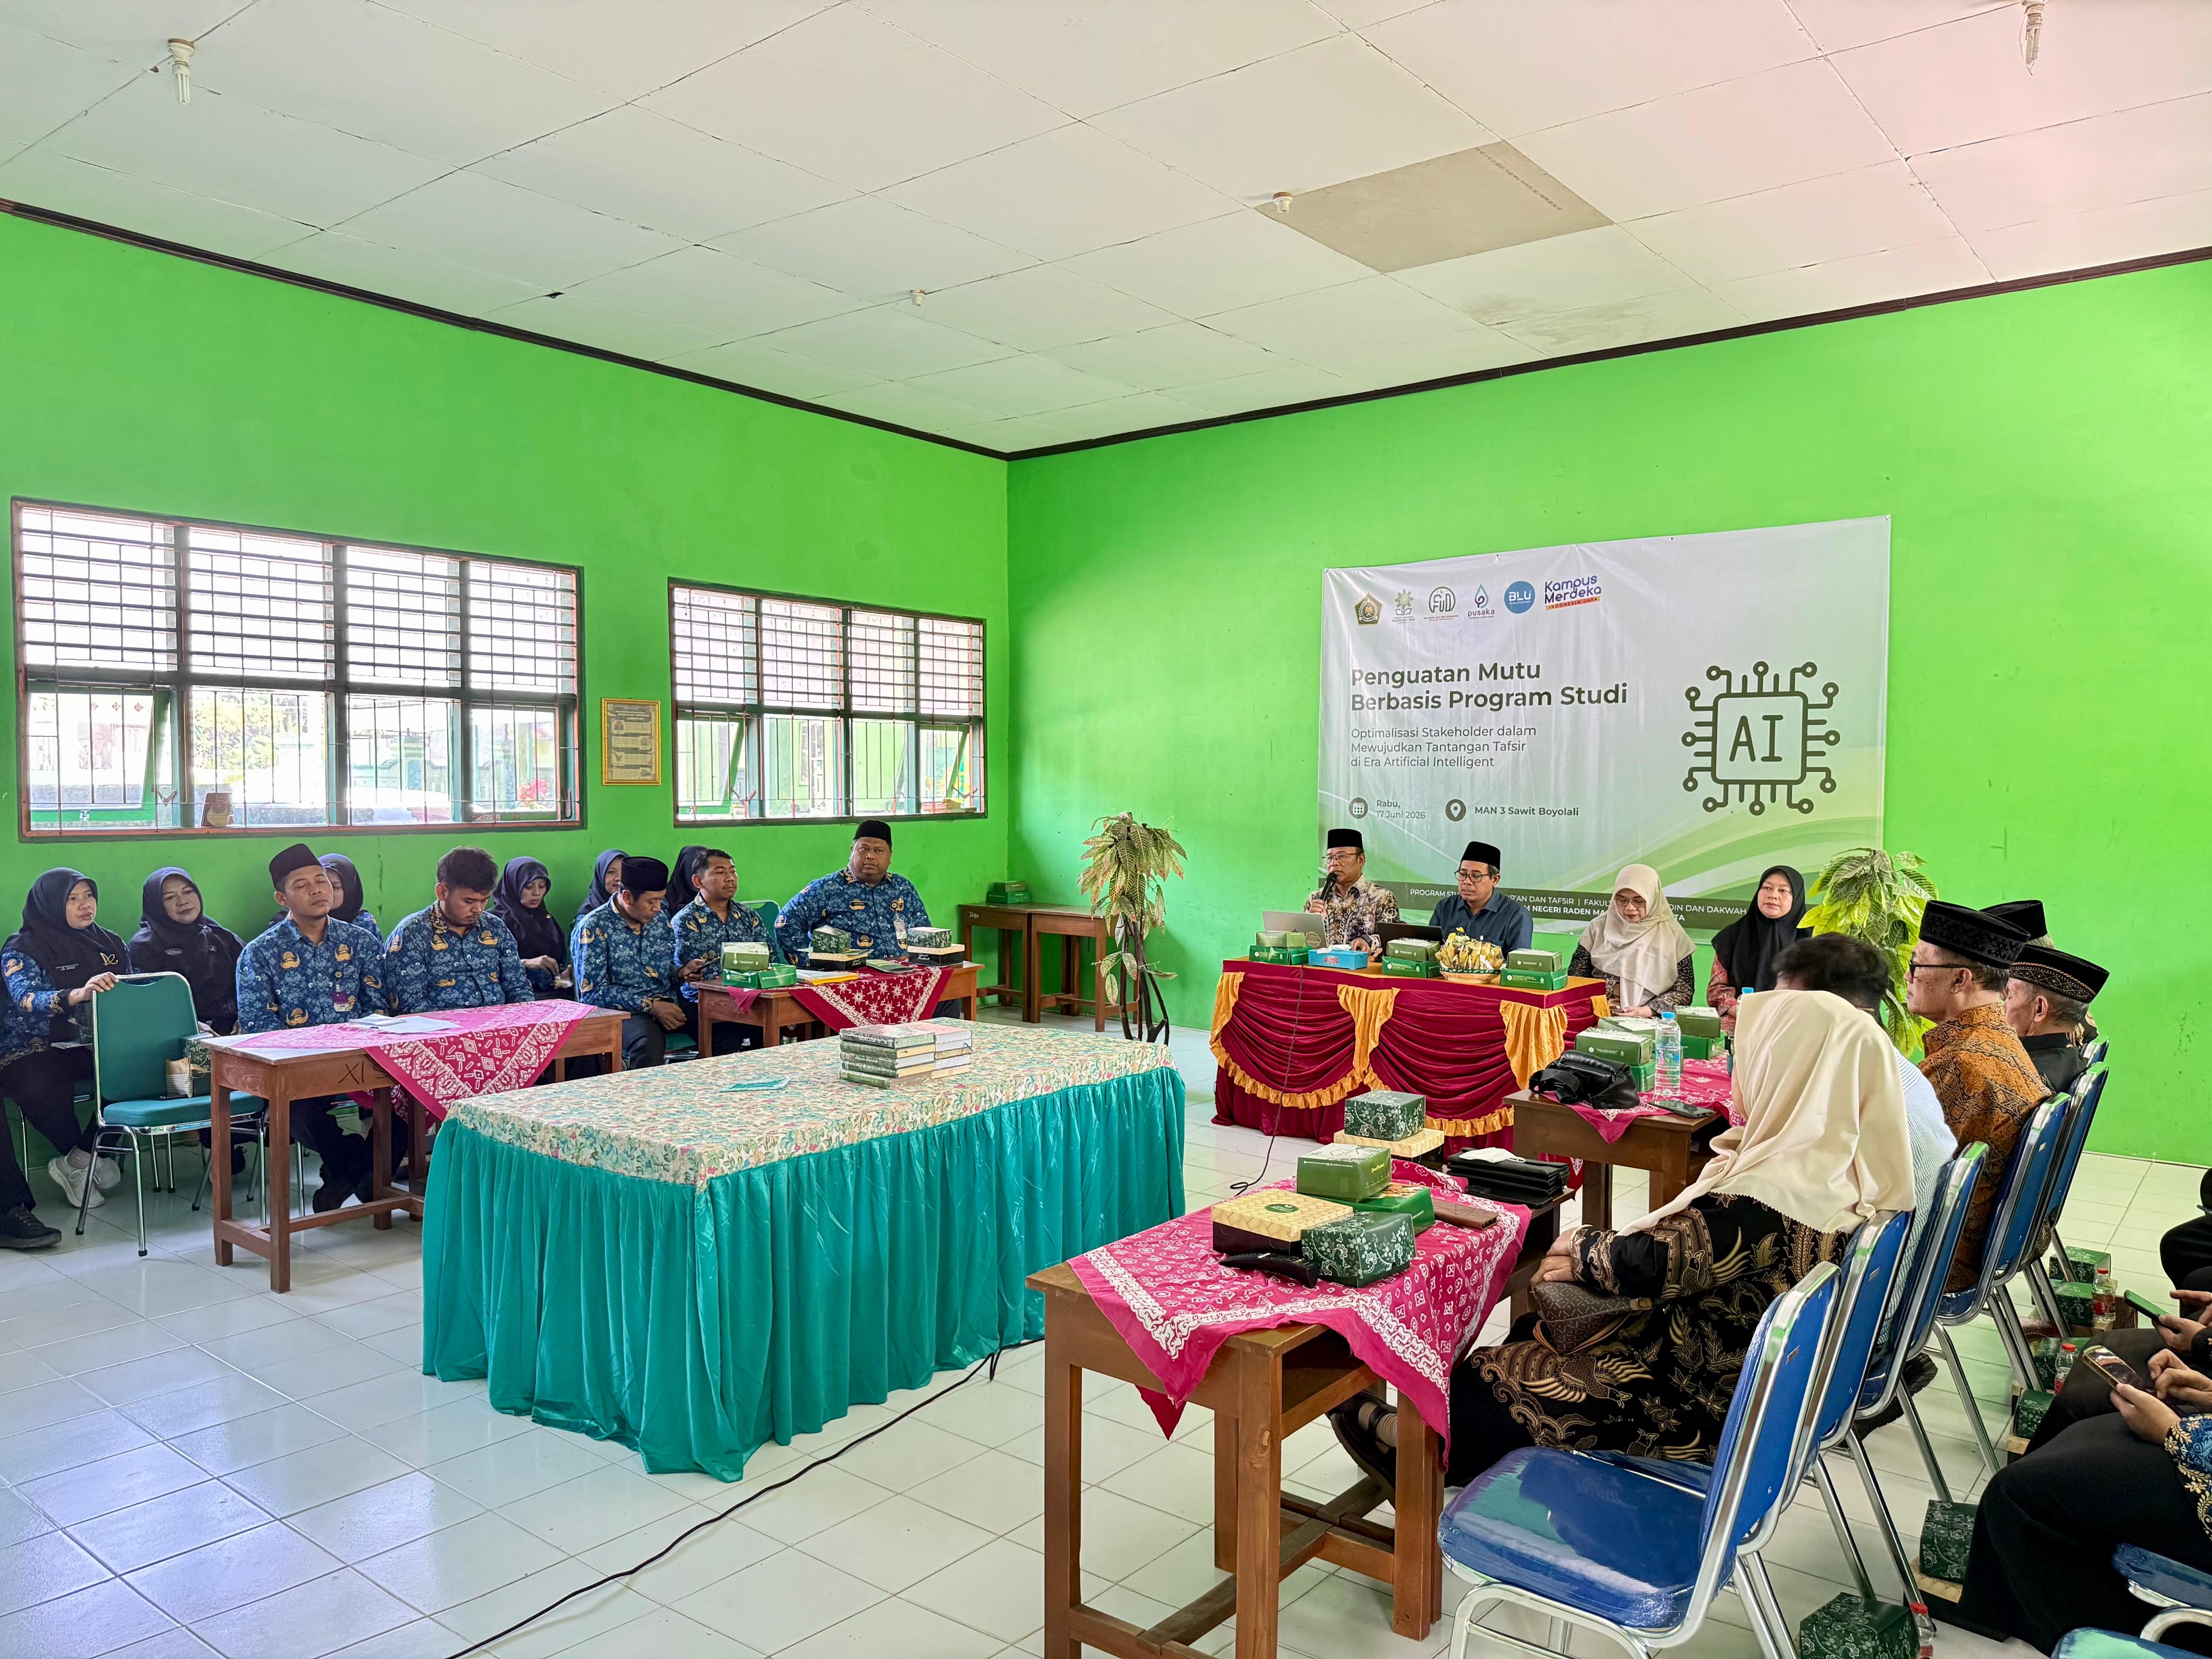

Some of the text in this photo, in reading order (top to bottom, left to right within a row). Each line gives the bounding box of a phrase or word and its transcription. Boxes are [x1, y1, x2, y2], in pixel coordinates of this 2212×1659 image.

[1545, 575, 1597, 593] Kampus
[1509, 591, 1531, 602] BLU
[1544, 586, 1602, 604] Merdeka
[1548, 599, 1581, 609] INDONESIA
[1468, 608, 1495, 617] pusaka
[1352, 663, 1540, 689] Penguatan Mutu
[1352, 682, 1627, 712] Berbasis Program Studi
[1351, 725, 1536, 740] Optimalisasi Stakeholder dalam
[1729, 715, 1783, 762] AI
[1351, 741, 1526, 755] Mewujudkan Tantangan Tafsir
[1351, 756, 1494, 769] di Era Artificial Intelligent
[1377, 800, 1400, 808] Rabu,
[1474, 806, 1497, 815] MAN
[1508, 807, 1536, 815] Sawit
[1538, 807, 1579, 817] Boyolali
[1410, 889, 1445, 897] PROGRAM
[1707, 906, 1746, 915] DAKWAH
[338, 1061, 365, 1084] XI
